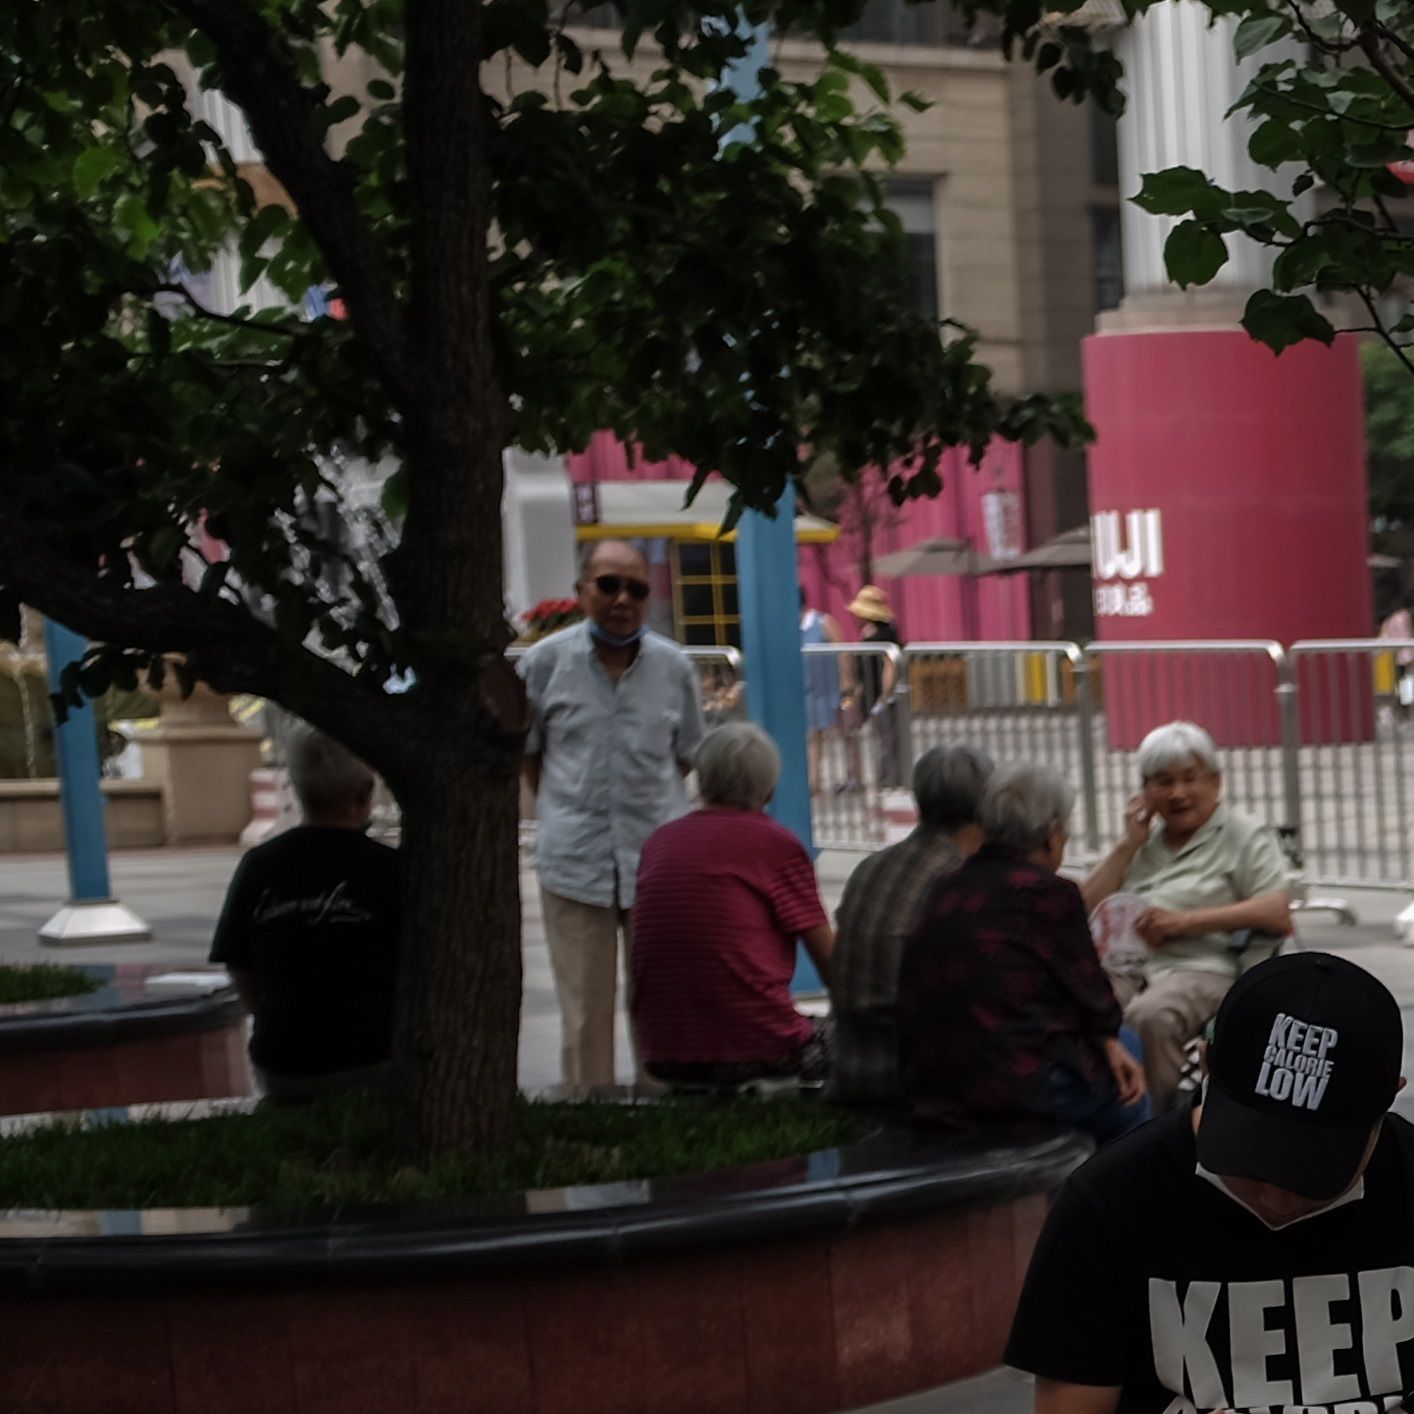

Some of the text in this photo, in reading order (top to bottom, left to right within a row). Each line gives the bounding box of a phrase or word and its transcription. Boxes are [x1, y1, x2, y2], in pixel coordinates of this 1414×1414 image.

[1268, 1012, 1339, 1060] KEEP
[1263, 1044, 1335, 1080] CALORIE
[1254, 1061, 1330, 1112] LOW
